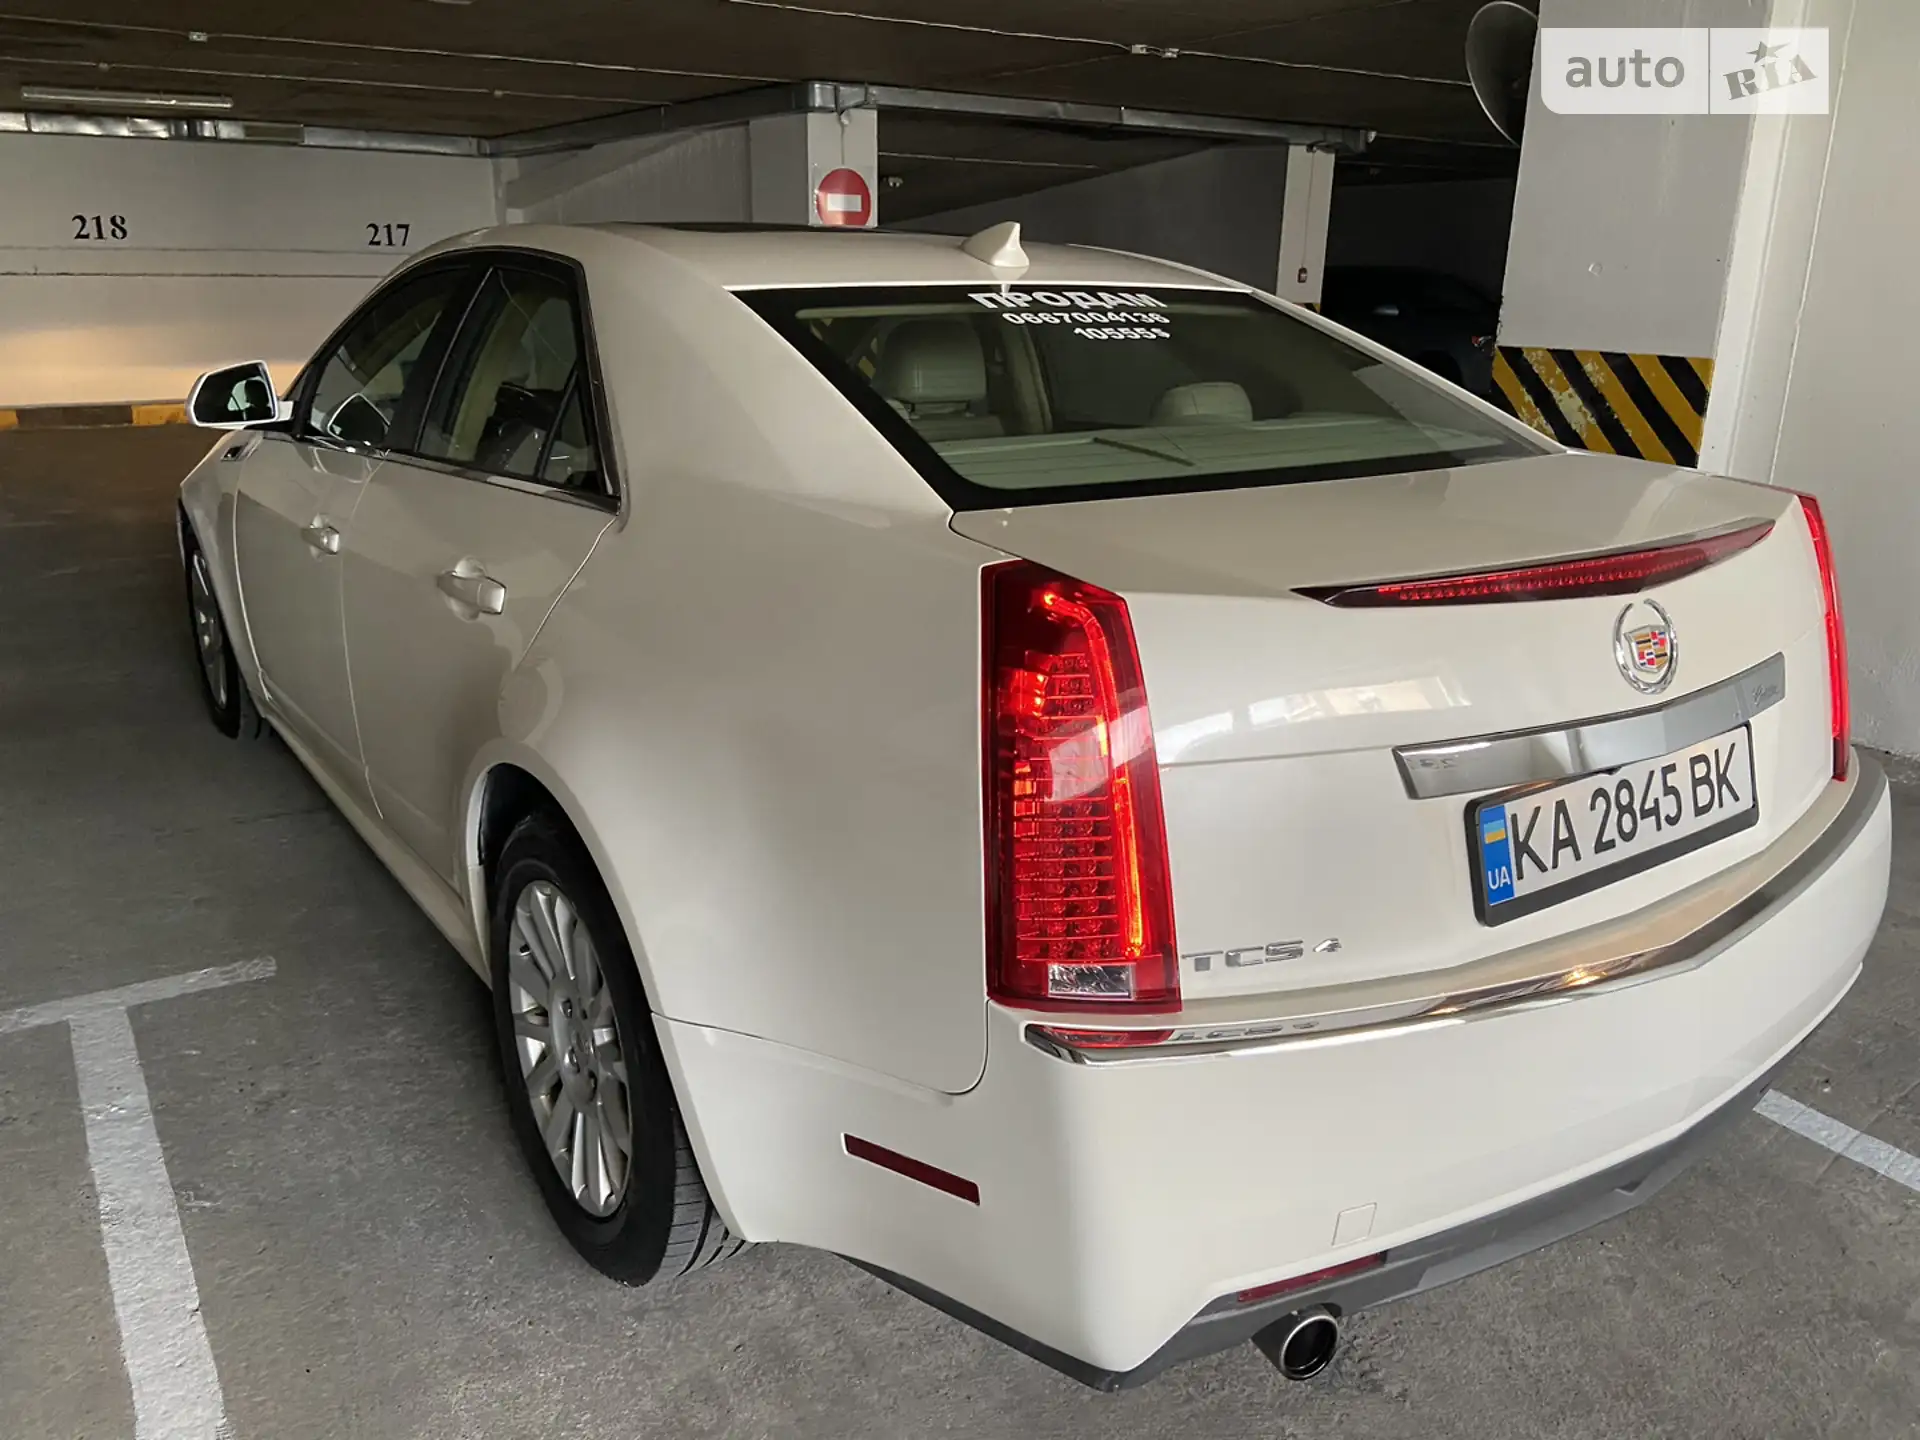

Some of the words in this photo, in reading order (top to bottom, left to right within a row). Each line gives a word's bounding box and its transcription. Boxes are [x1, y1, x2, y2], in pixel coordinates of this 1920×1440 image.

[71, 214, 127, 240] 218
[366, 223, 410, 246] 217
[968, 291, 1168, 309] ПРОДАМ
[1002, 311, 1170, 324] 0667004136
[1510, 799, 1582, 881] KA
[1589, 763, 1683, 855] 2845
[1688, 742, 1741, 818] BK
[1487, 866, 1512, 891] UA
